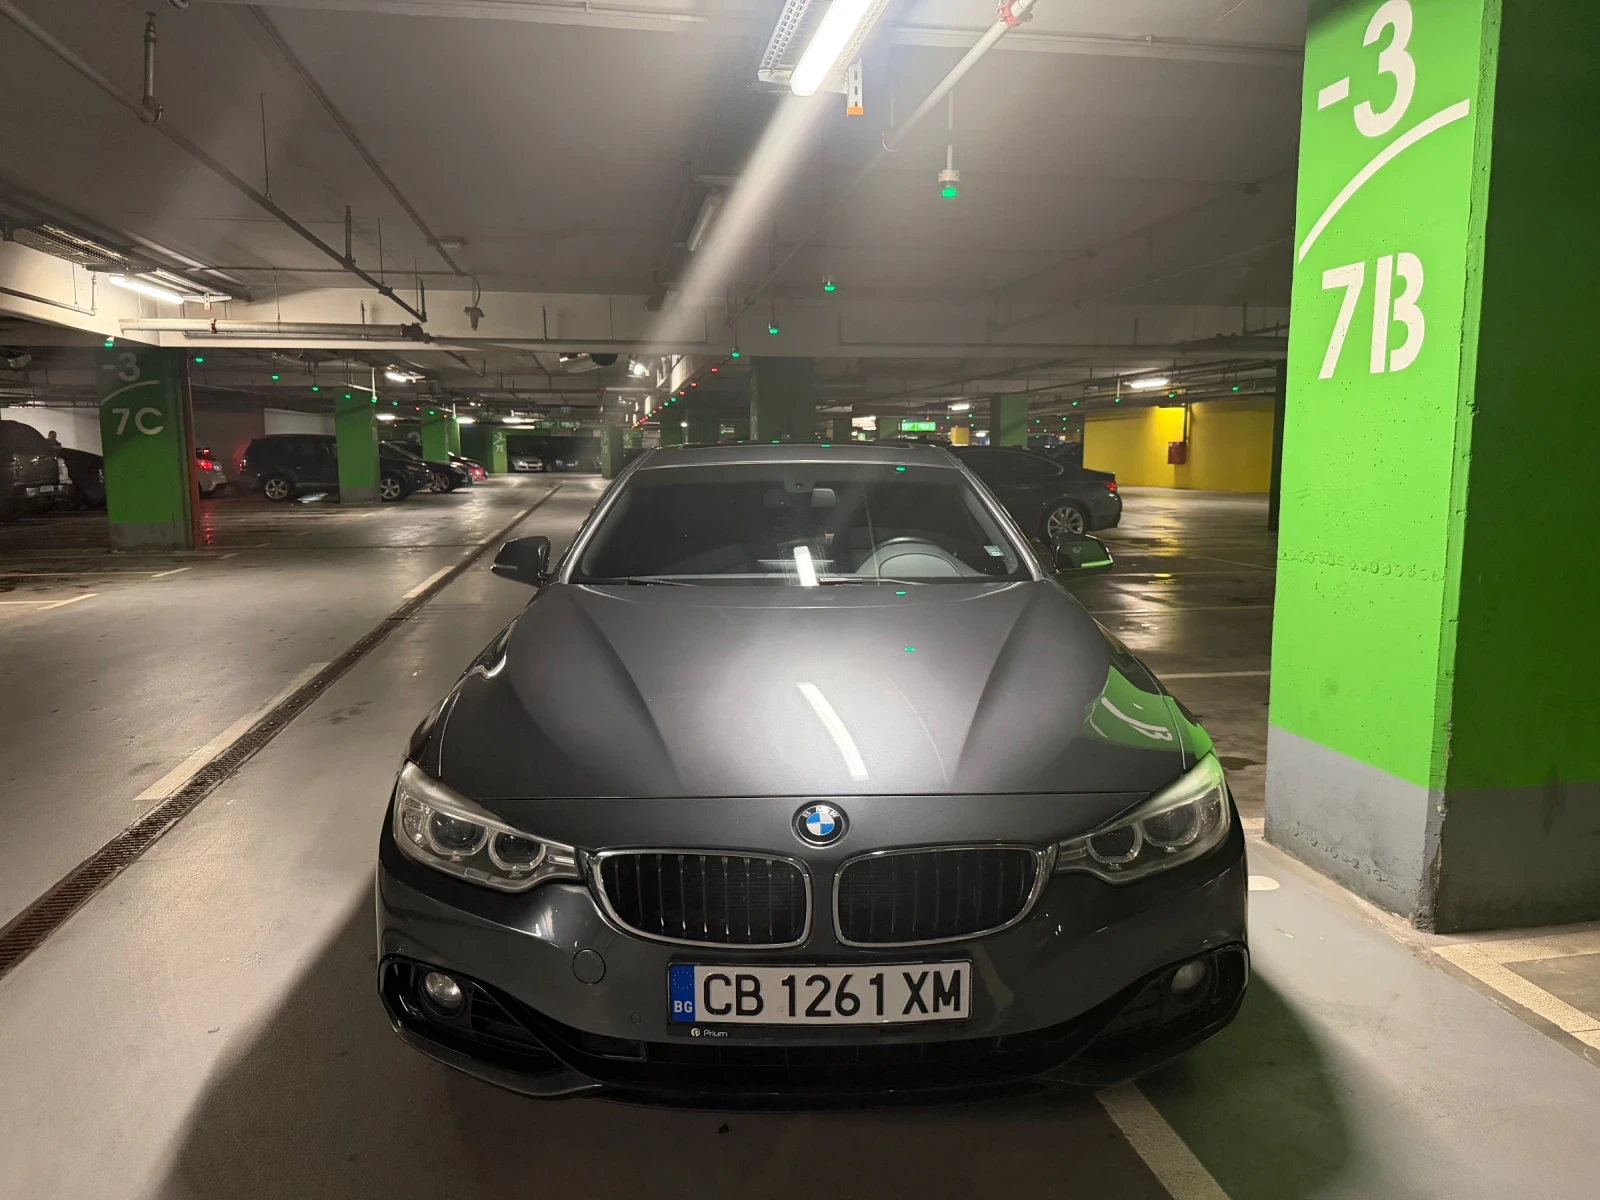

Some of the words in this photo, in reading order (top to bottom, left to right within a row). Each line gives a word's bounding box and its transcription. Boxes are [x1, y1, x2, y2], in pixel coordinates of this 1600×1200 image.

[1317, 0, 1416, 138] -3
[1317, 251, 1426, 380] 7B
[102, 352, 140, 381] -3
[112, 407, 164, 435] 7C
[801, 805, 841, 819] BMW
[673, 1000, 693, 1013] BG
[703, 972, 764, 1016] CB
[781, 973, 884, 1018] 1261
[901, 969, 961, 1015] XM
[703, 1028, 728, 1037] Prium
